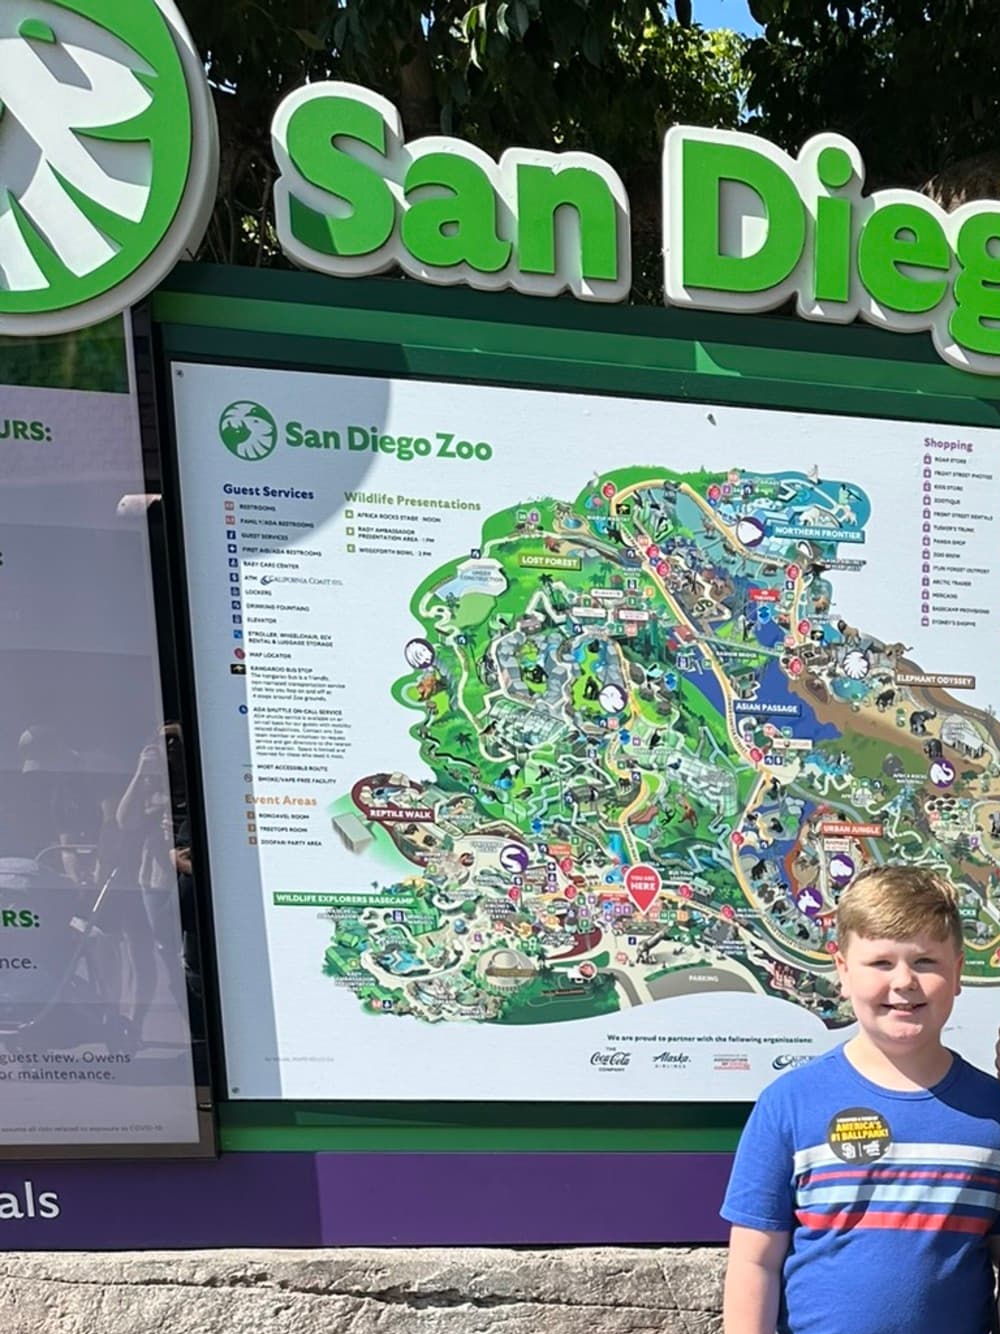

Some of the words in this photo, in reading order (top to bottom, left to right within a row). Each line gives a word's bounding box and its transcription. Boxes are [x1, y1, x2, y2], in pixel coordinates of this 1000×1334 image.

[286, 97, 618, 280] San
[285, 421, 341, 450] San
[347, 426, 432, 461] Diego
[435, 433, 493, 461] Zoo
[924, 438, 973, 453] Shopping
[223, 484, 260, 496] Guest
[262, 486, 314, 500] Services
[344, 491, 394, 505] Wildlife
[397, 495, 481, 511] Presentations
[776, 527, 820, 537] NORTHERN
[822, 528, 861, 539] FRONTIER
[521, 556, 542, 565] LOST
[545, 558, 578, 567] FOREST
[897, 674, 935, 684] ELEPHANT
[937, 676, 973, 686] ODYSSEY
[736, 703, 761, 712] ASIAN
[762, 704, 798, 713] PASSAGE
[245, 794, 279, 806] Event
[283, 795, 317, 806] Areas
[369, 809, 403, 819] REPTILE
[406, 810, 431, 819] WALK
[823, 825, 850, 833] URBAN
[851, 826, 880, 834] JUNGLE
[630, 882, 656, 891] HERE
[276, 894, 317, 903] WILDLIFE
[318, 895, 367, 904] EXPLORERS
[368, 896, 415, 905] BASECAMP
[689, 974, 719, 982] PARKING
[728, 1035, 762, 1044] following
[0, 1053, 39, 1066] guest
[42, 1052, 79, 1063] view.
[82, 1051, 131, 1063] Owens
[18, 1068, 116, 1080] maintenance.
[835, 1120, 882, 1131] AMERICA'S
[842, 1128, 889, 1140] BALLPARK!
[0, 1181, 60, 1219] als
